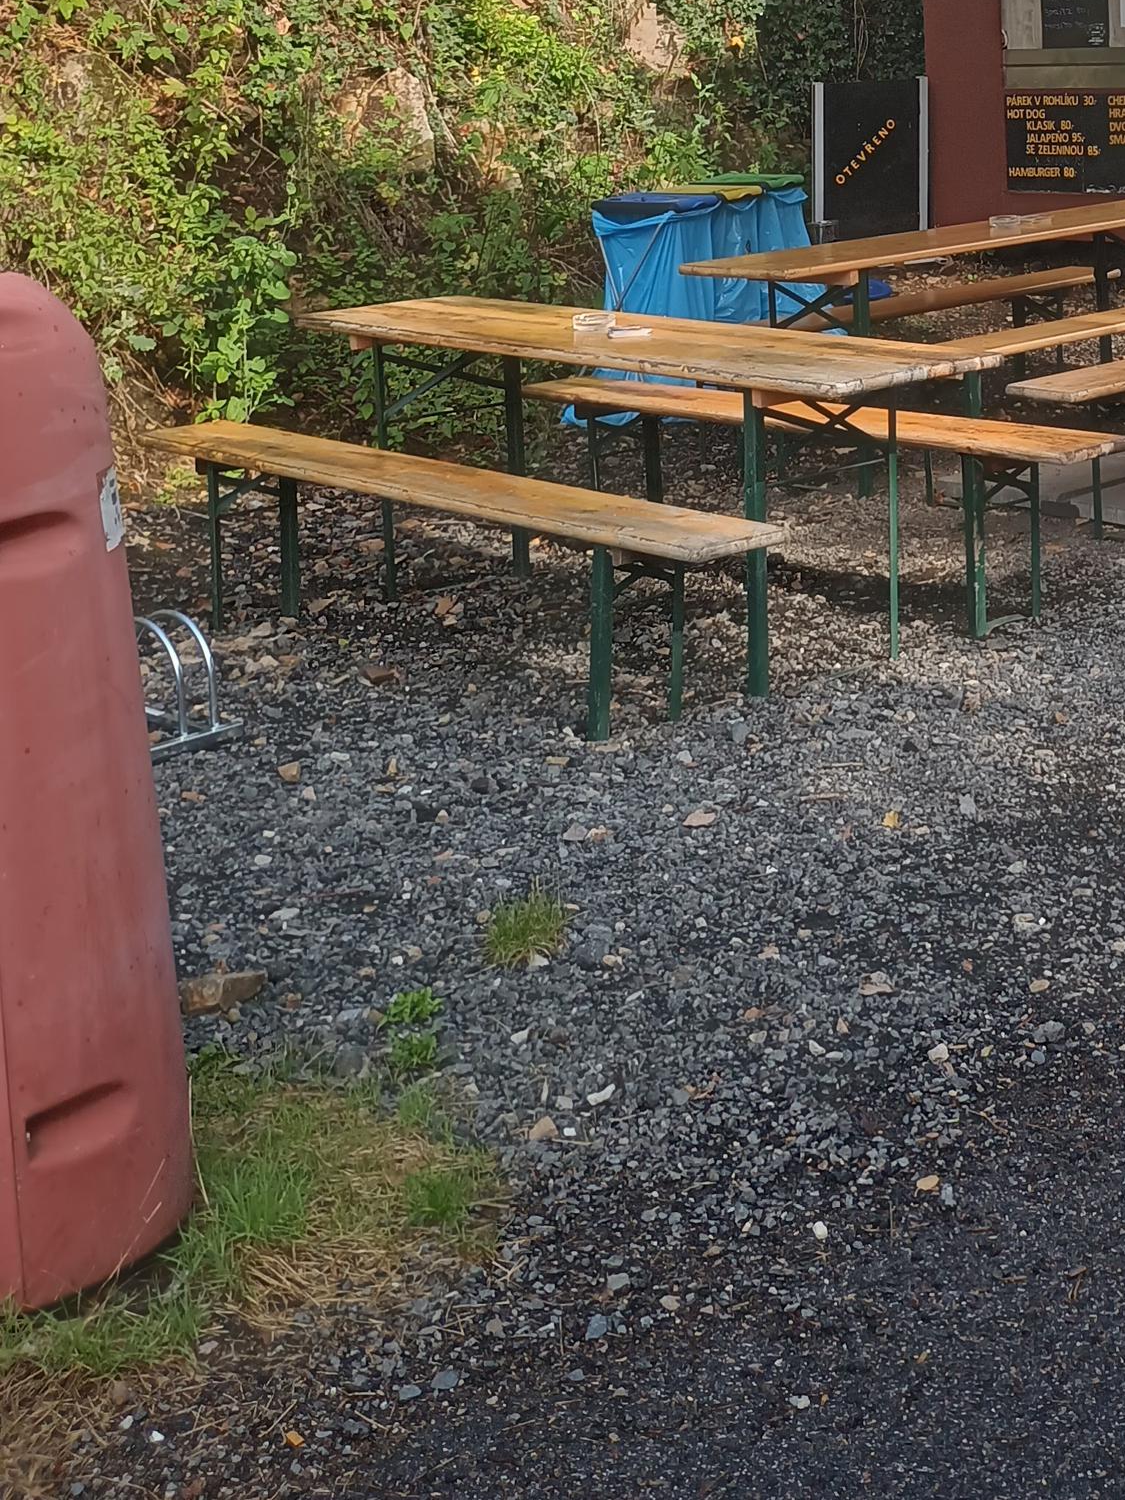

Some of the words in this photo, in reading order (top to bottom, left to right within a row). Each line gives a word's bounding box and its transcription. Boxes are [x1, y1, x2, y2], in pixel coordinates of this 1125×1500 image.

[1006, 94, 1032, 106] PÁREK
[1034, 96, 1041, 105] V
[1043, 93, 1079, 106] ROHLÍKU
[1007, 109, 1024, 119] HOT
[1026, 109, 1046, 119] DOG
[1026, 120, 1055, 130] KLASIK
[835, 118, 896, 185] OTEVŘENO
[1026, 144, 1036, 154] SE
[1038, 145, 1084, 155] ZELENINOU
[1008, 167, 1061, 178] HAMBURGER
